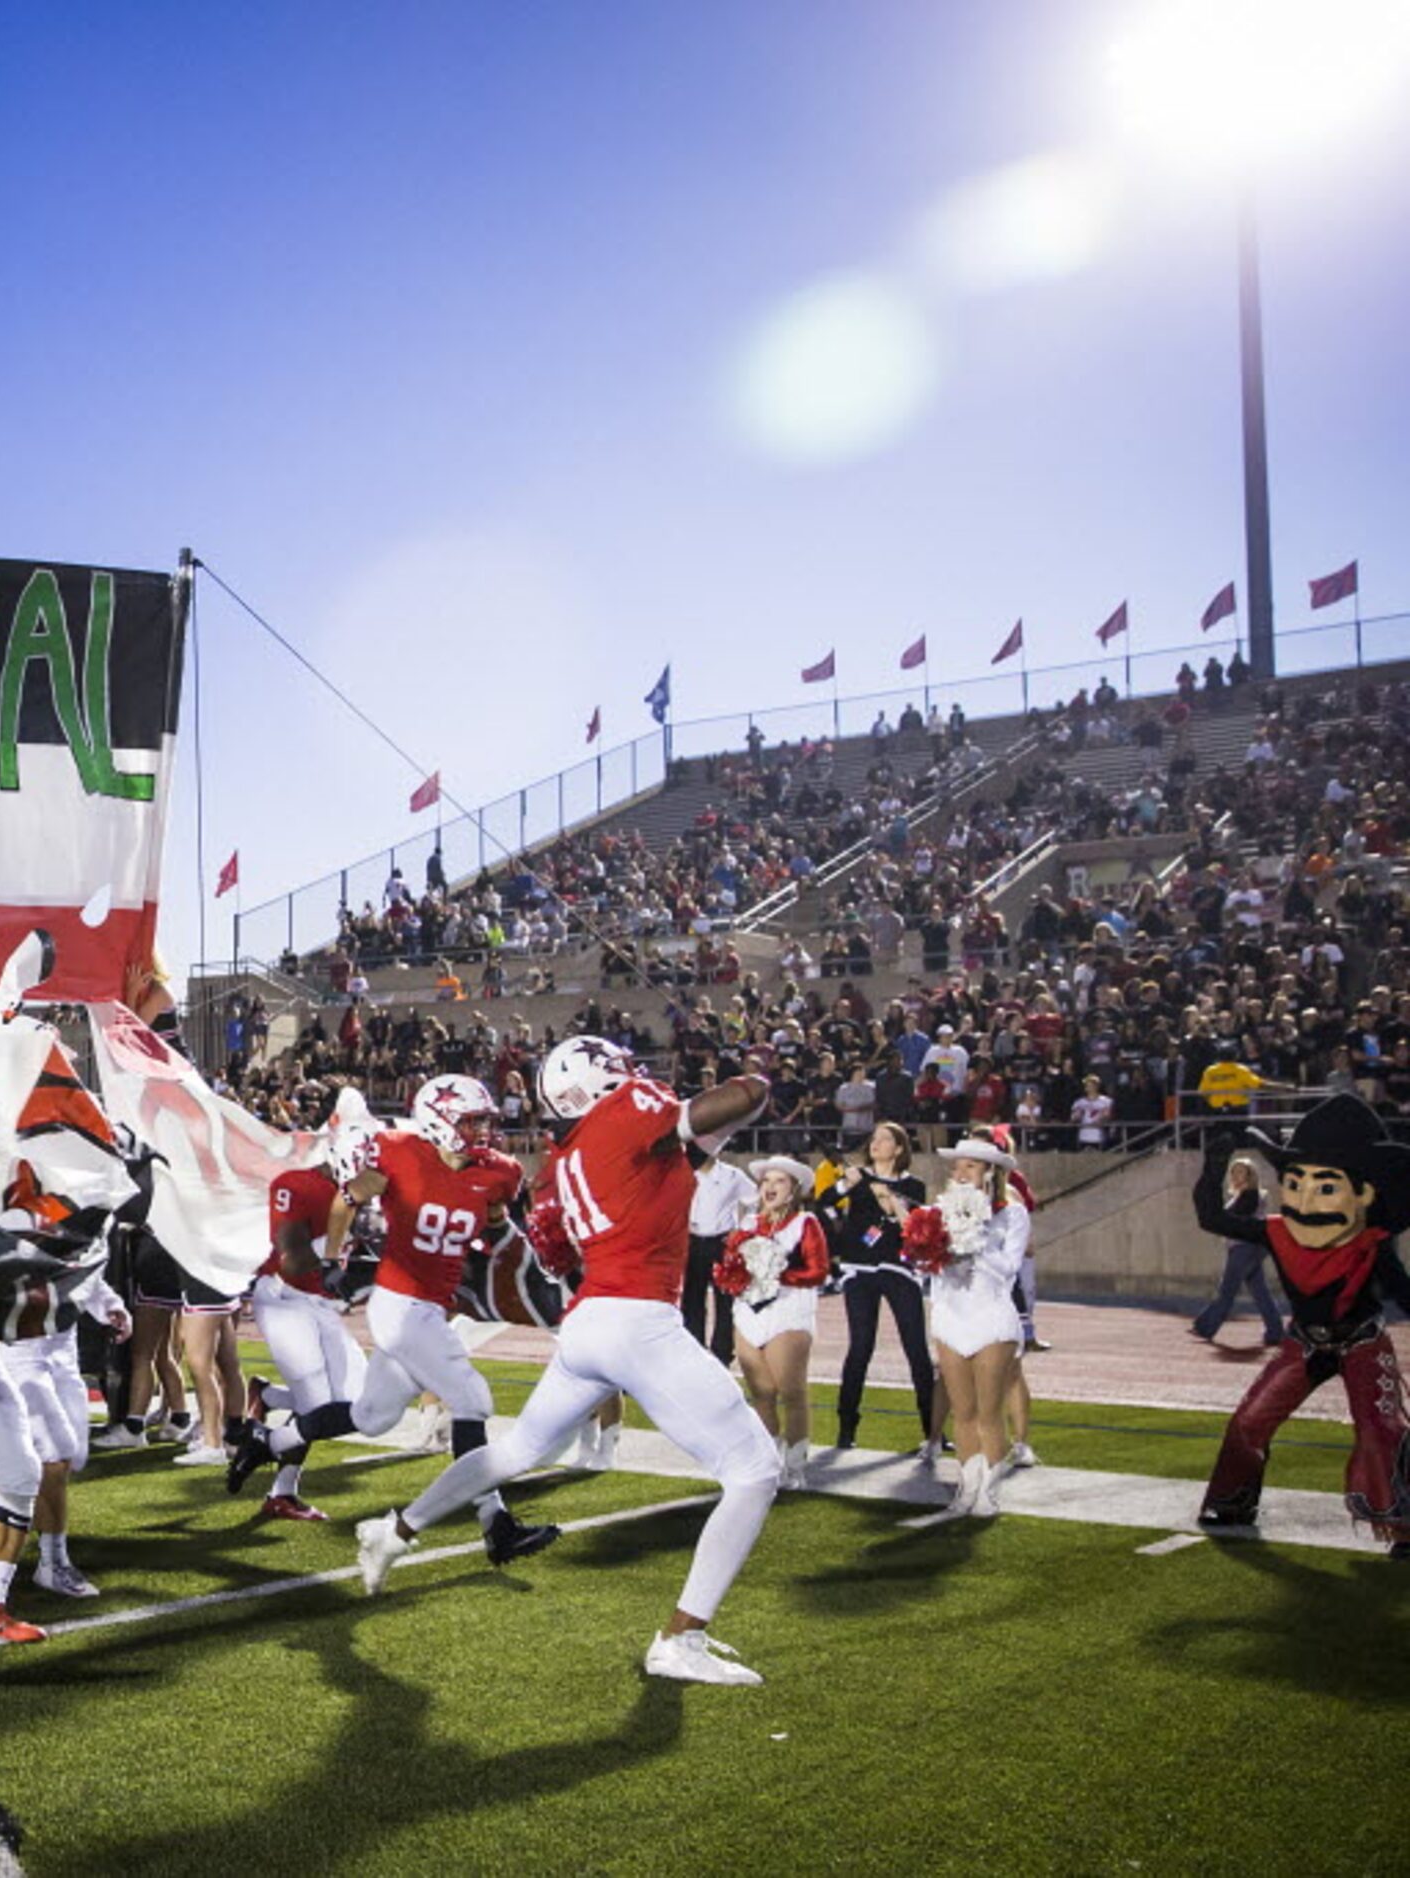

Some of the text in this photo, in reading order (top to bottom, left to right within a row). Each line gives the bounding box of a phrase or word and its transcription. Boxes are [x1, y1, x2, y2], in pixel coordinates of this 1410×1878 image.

[275, 1187, 291, 1212] 9
[556, 1147, 614, 1240] 41
[412, 1202, 477, 1256] 92
